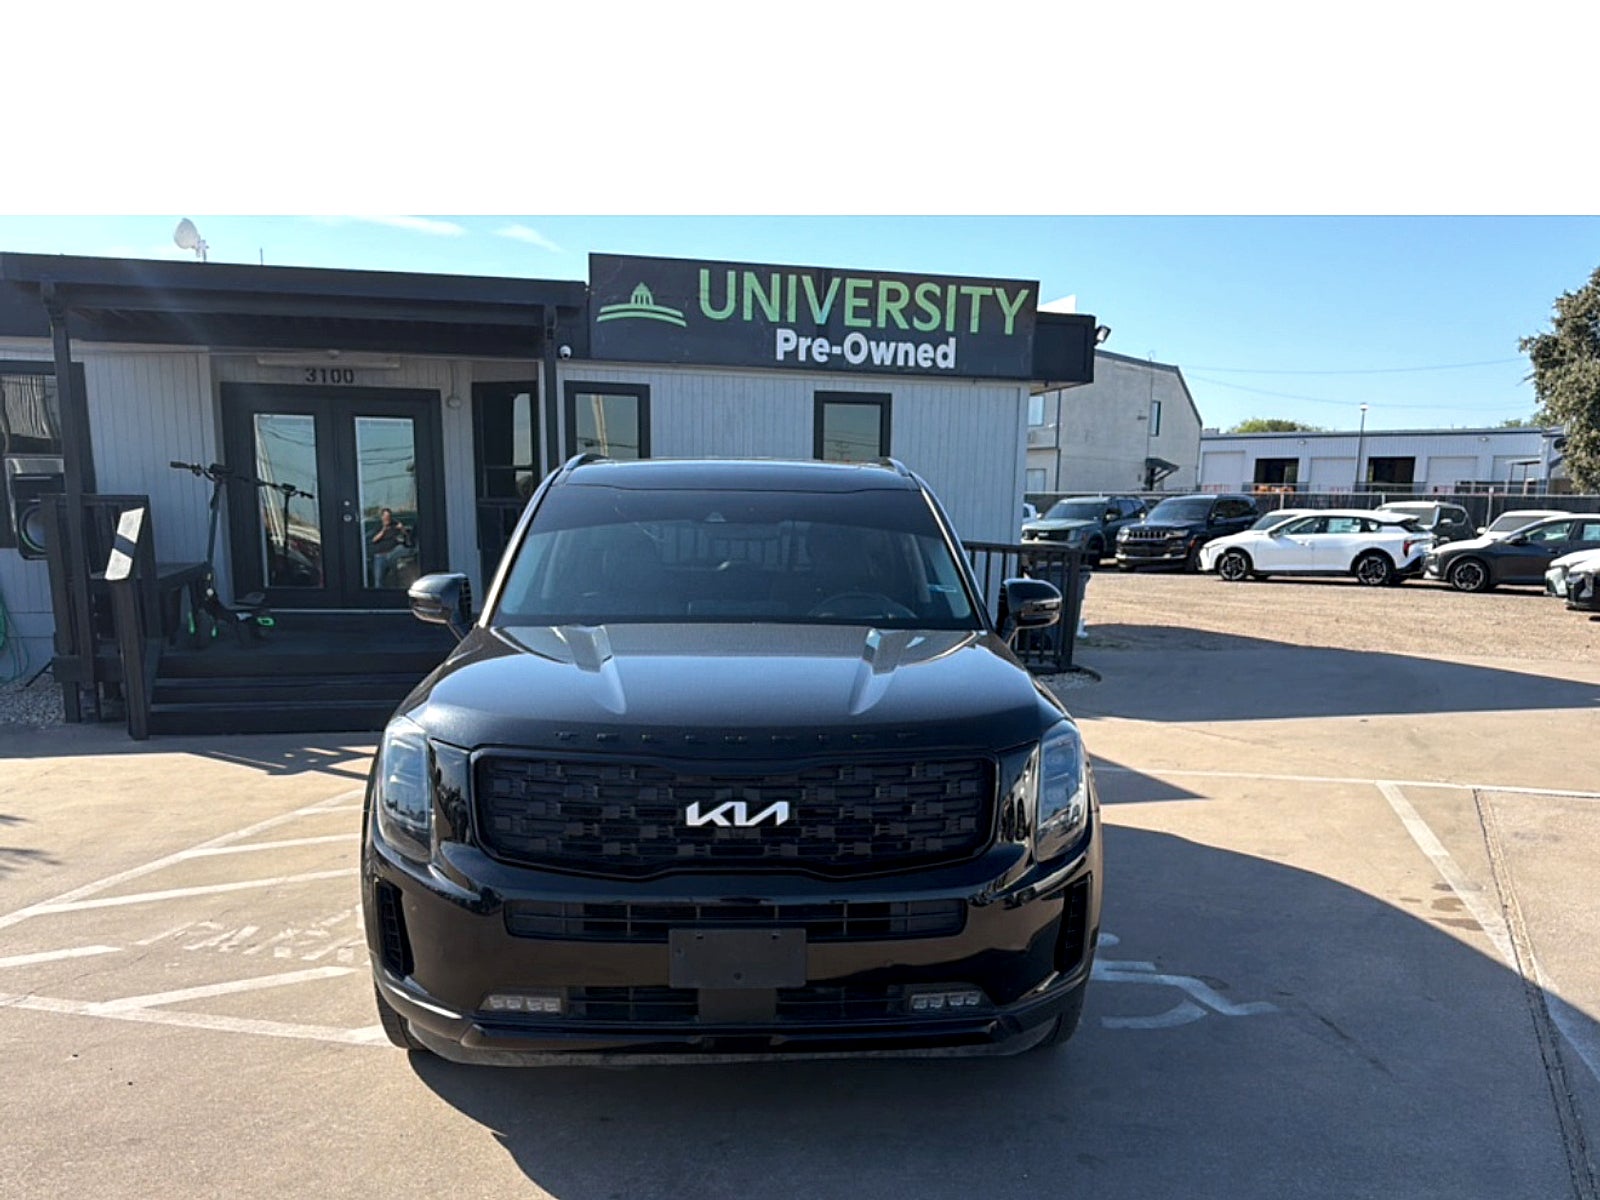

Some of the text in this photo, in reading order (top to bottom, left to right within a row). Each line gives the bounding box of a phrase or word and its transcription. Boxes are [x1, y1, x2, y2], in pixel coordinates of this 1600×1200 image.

[699, 268, 1029, 336] UNIVERSITY
[776, 327, 957, 370] Pre-Owned
[304, 367, 355, 384] 3100
[686, 801, 789, 826] KIA
